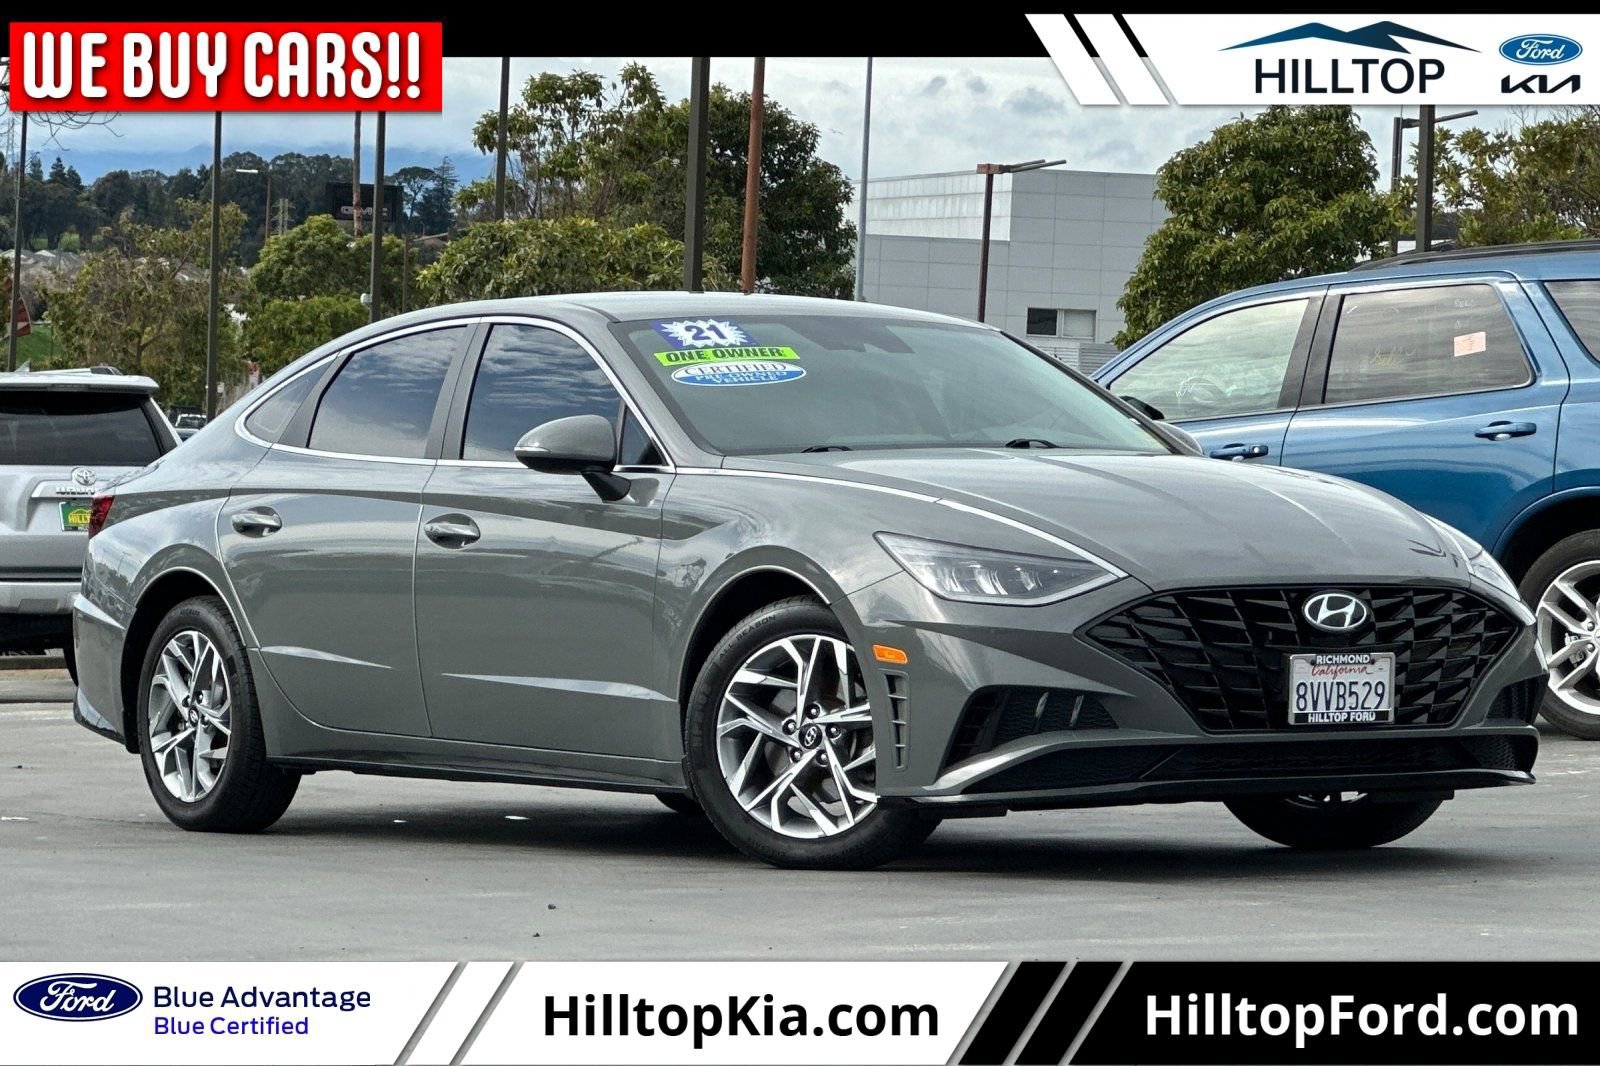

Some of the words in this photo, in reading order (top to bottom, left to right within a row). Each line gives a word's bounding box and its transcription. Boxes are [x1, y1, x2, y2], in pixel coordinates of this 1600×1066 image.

[684, 324, 728, 341] 21
[665, 350, 710, 363] ONE
[713, 348, 784, 359] OWNER
[685, 363, 787, 376] CERTIFIED
[712, 374, 779, 384] VEHICLE
[1316, 654, 1370, 665] RICHMOND
[1311, 663, 1374, 680] California
[1296, 681, 1385, 711] 8VVB529
[1307, 713, 1348, 723] HILLTOP
[1349, 711, 1376, 722] FORD
